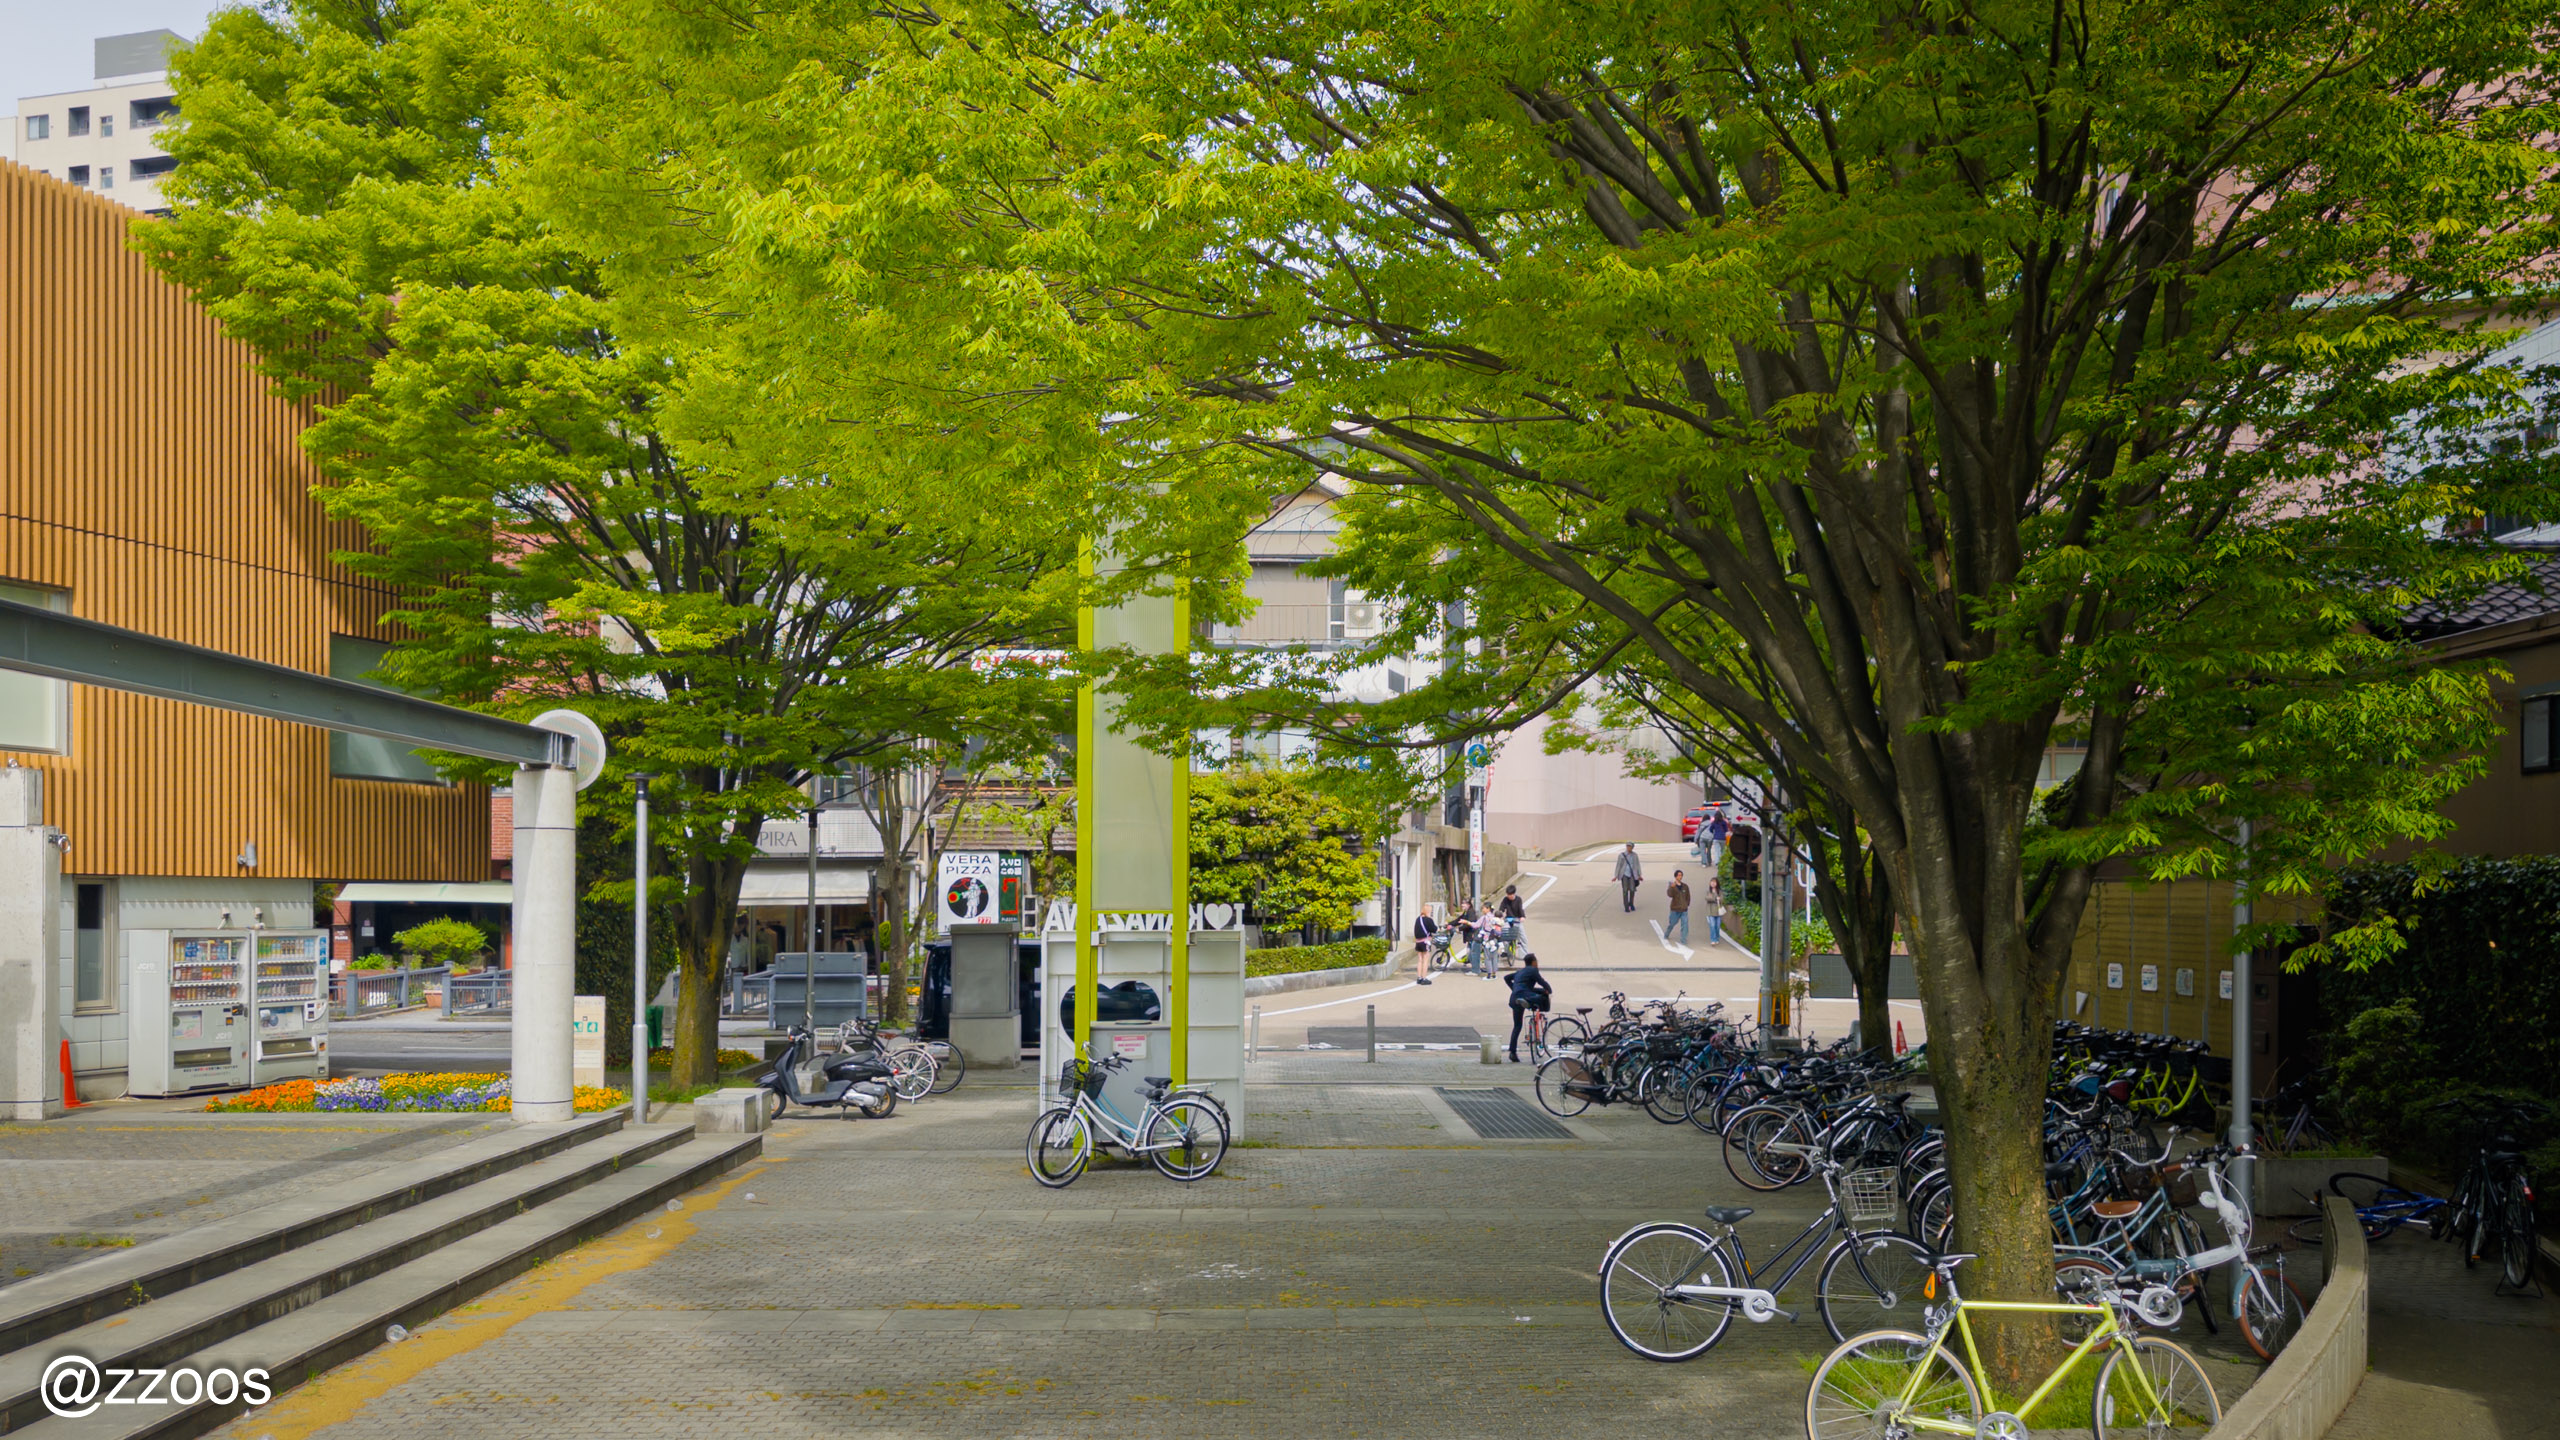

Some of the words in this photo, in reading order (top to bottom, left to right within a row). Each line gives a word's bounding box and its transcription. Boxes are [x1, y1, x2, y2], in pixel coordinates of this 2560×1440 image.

[946, 855, 992, 864] VERA
[1000, 858, 1022, 867] 入り口
[946, 866, 992, 875] PIZZA
